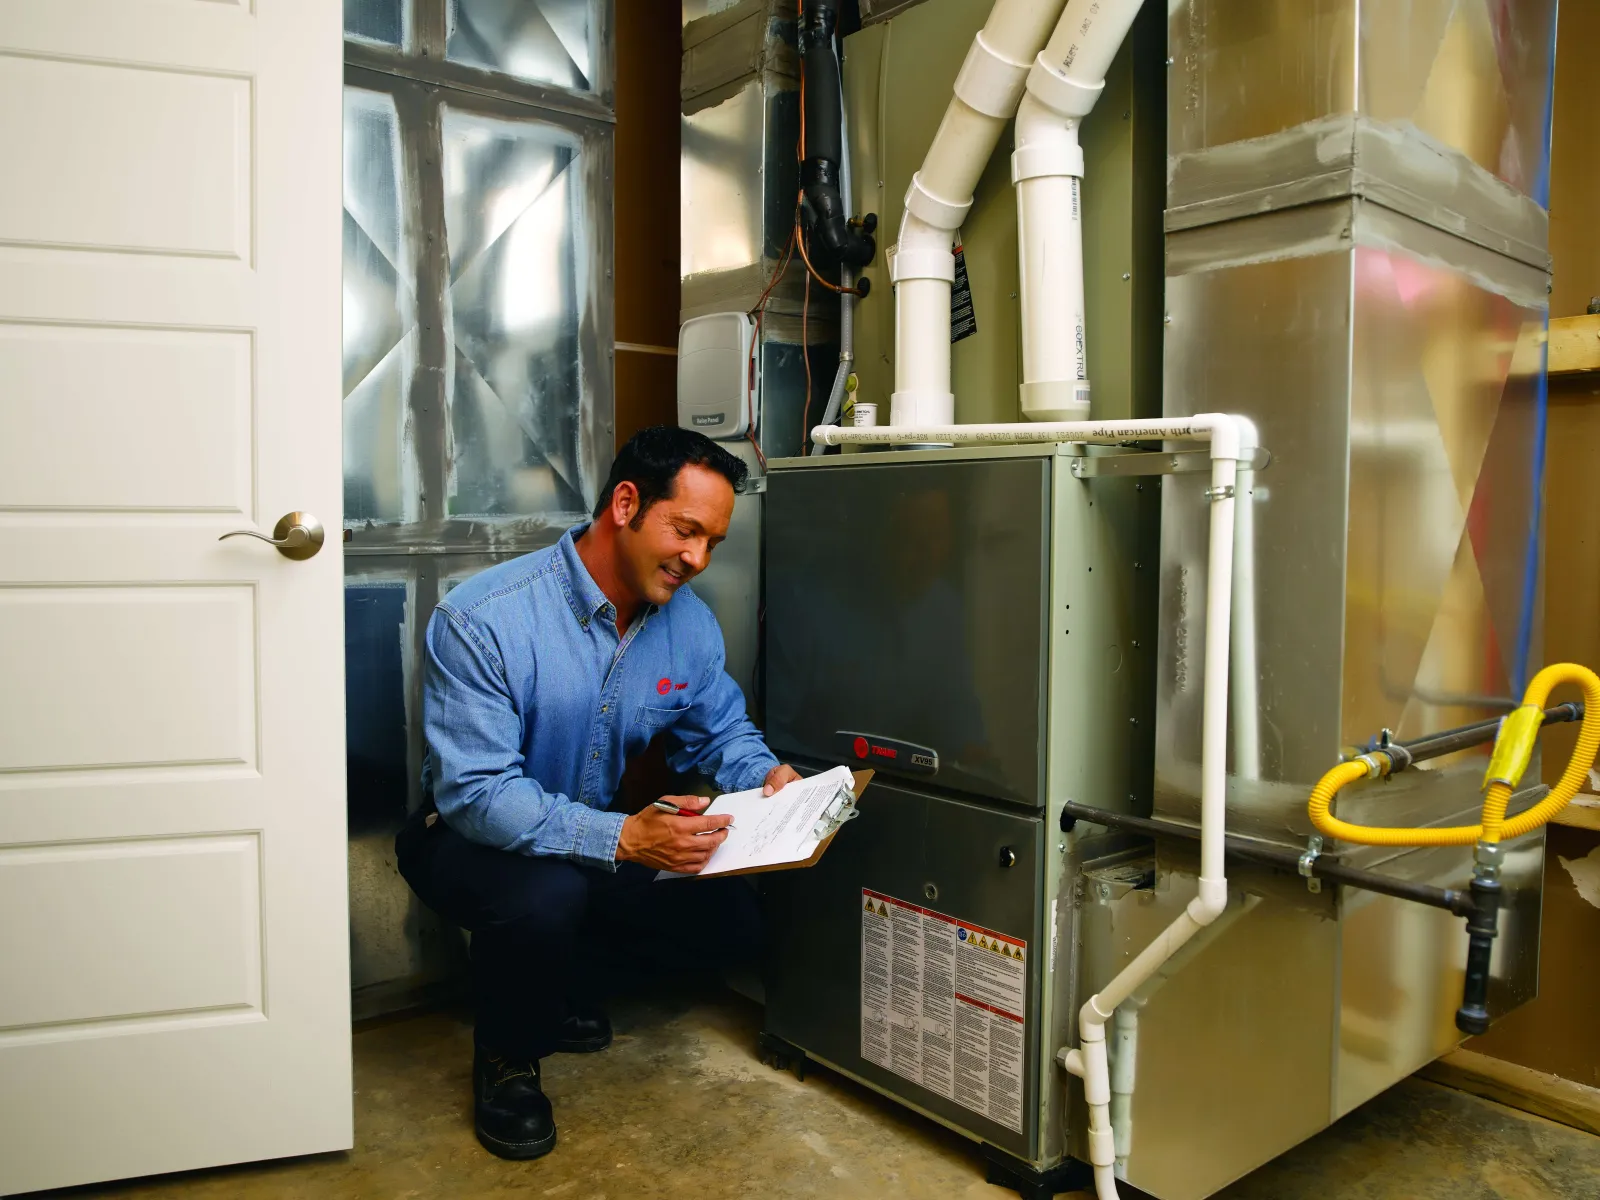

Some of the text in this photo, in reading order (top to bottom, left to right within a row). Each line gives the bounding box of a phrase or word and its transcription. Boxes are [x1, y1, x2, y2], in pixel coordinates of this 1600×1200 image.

[1014, 432, 1033, 440] ASTM
[1092, 427, 1115, 438] Pipe
[1117, 426, 1167, 437] American
[914, 755, 933, 766] XV95
